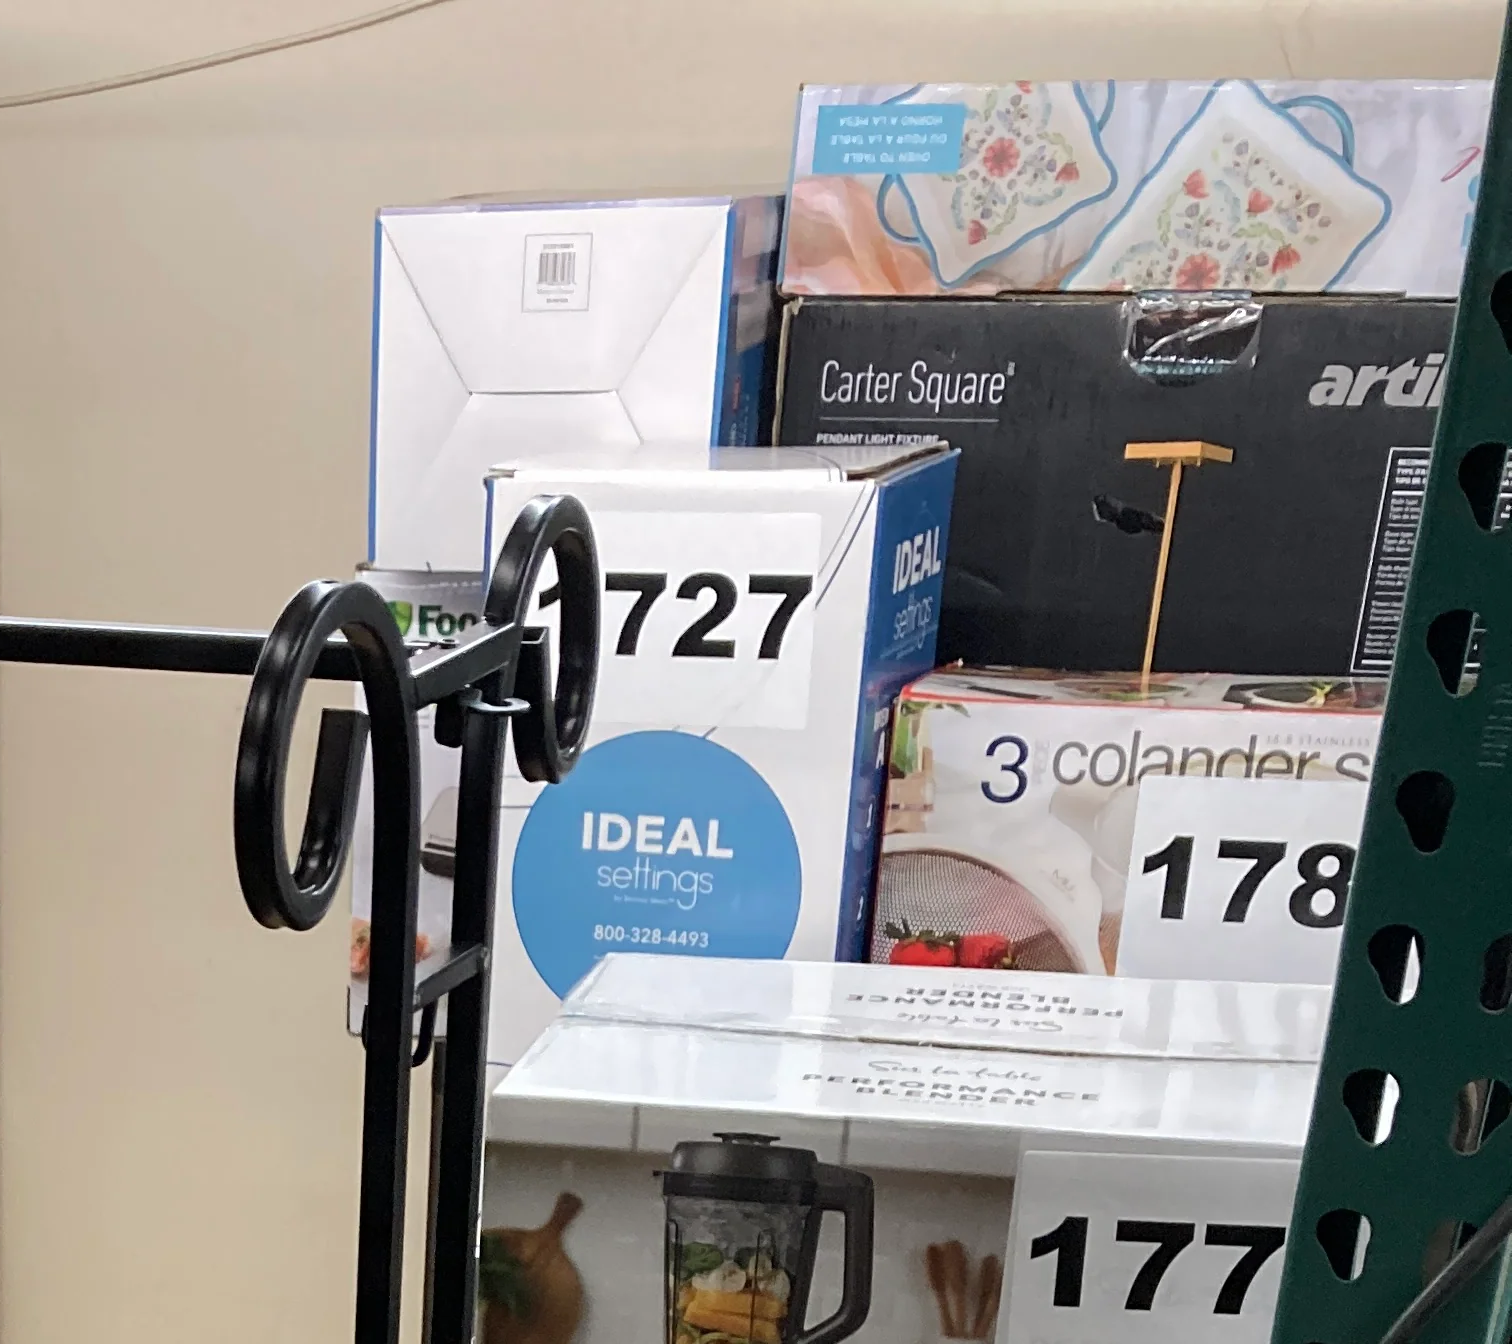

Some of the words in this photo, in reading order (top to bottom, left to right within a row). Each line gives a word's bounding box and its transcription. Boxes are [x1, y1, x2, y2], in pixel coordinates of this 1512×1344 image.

[843, 151, 876, 162] TABLE
[880, 152, 894, 162] TO
[899, 152, 930, 163] OVEN
[820, 360, 902, 403] Carter
[908, 360, 1005, 413] Square
[817, 433, 865, 444] PENDANT
[866, 433, 894, 444] LIGHT
[896, 434, 939, 445] FIXTURE
[892, 526, 941, 594] IDEAL
[892, 597, 934, 648] settings
[981, 735, 1029, 803] 3
[1052, 730, 1320, 787] colander
[582, 811, 734, 859] IDEAL
[597, 856, 714, 910] settings
[593, 924, 709, 948] 800-328-4493
[847, 993, 1123, 1018] PERFORMANCE
[907, 987, 1070, 1004] BLENDER
[856, 1086, 1038, 1106] BLENDER
[1029, 1216, 1287, 1315] 177
